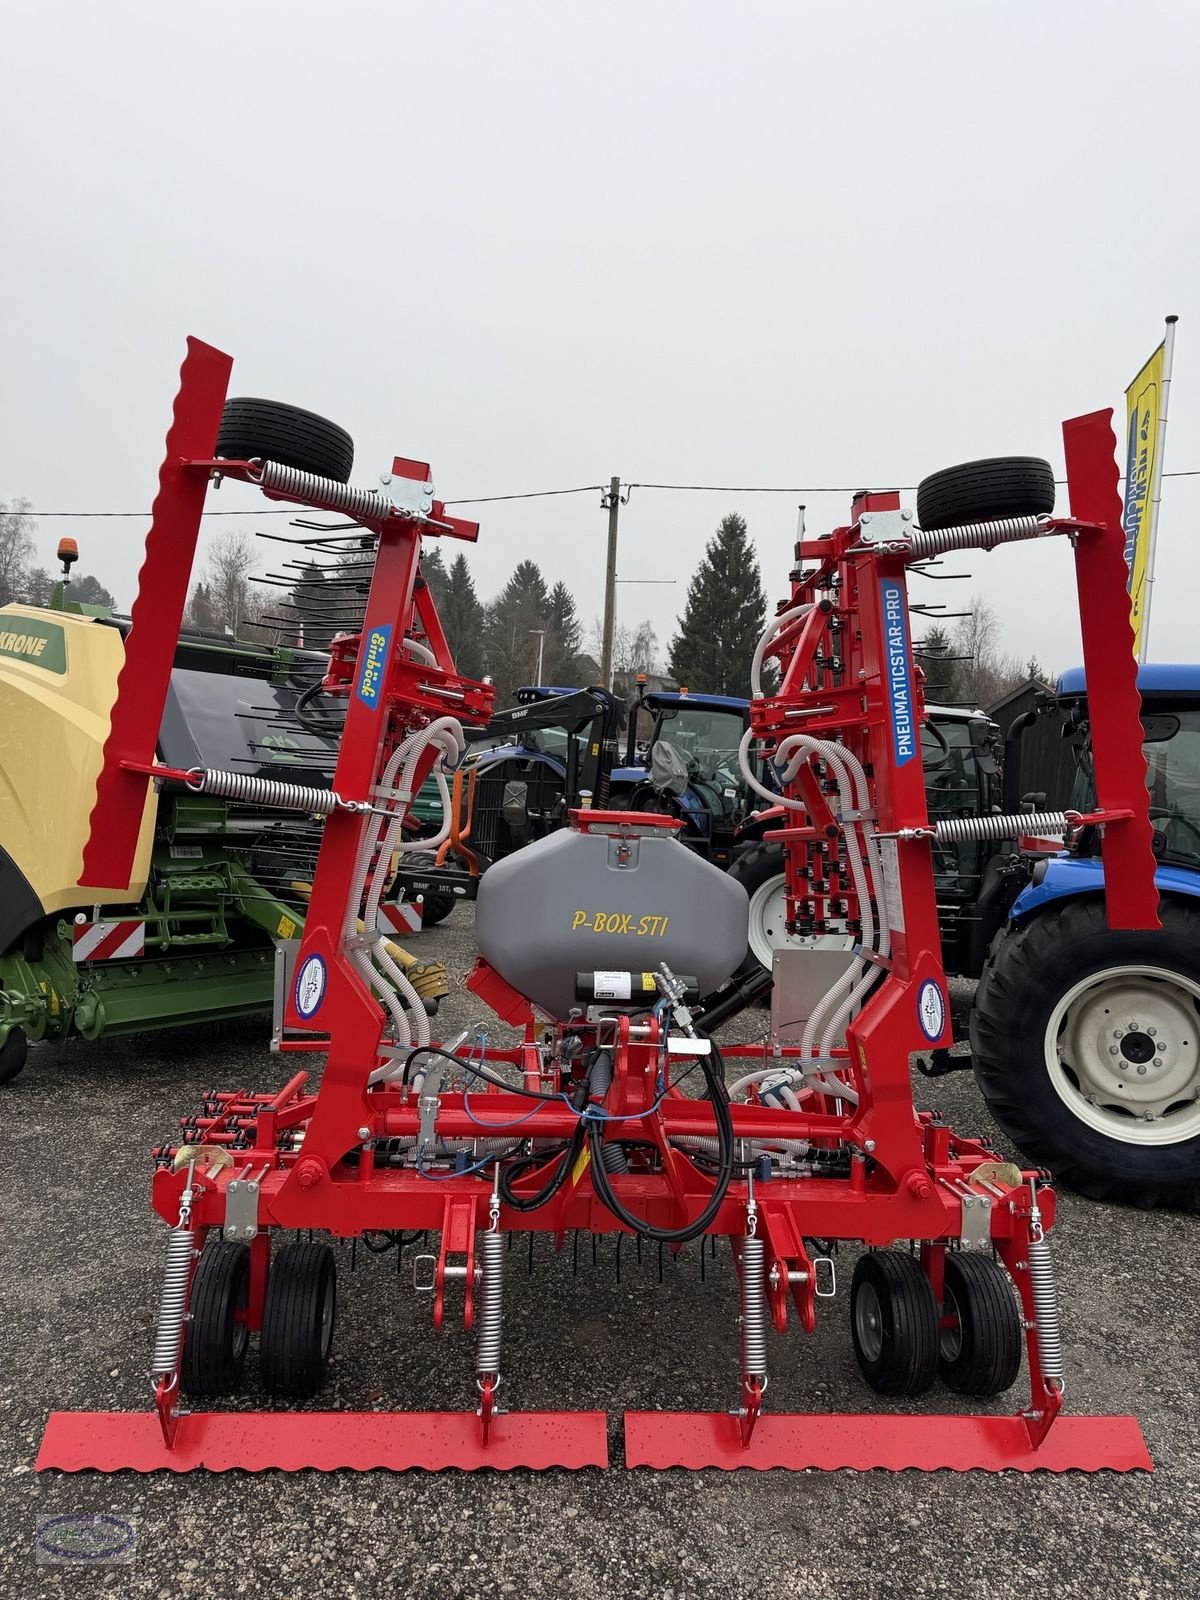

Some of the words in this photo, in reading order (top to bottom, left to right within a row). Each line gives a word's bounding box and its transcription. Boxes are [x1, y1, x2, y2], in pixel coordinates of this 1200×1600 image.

[0, 631, 48, 657] KRONE
[361, 632, 386, 698] Einböck
[885, 588, 912, 756] PNEUMATICSTAR-PRO
[511, 708, 529, 720] BMF
[572, 910, 669, 937] P-BOX-STI
